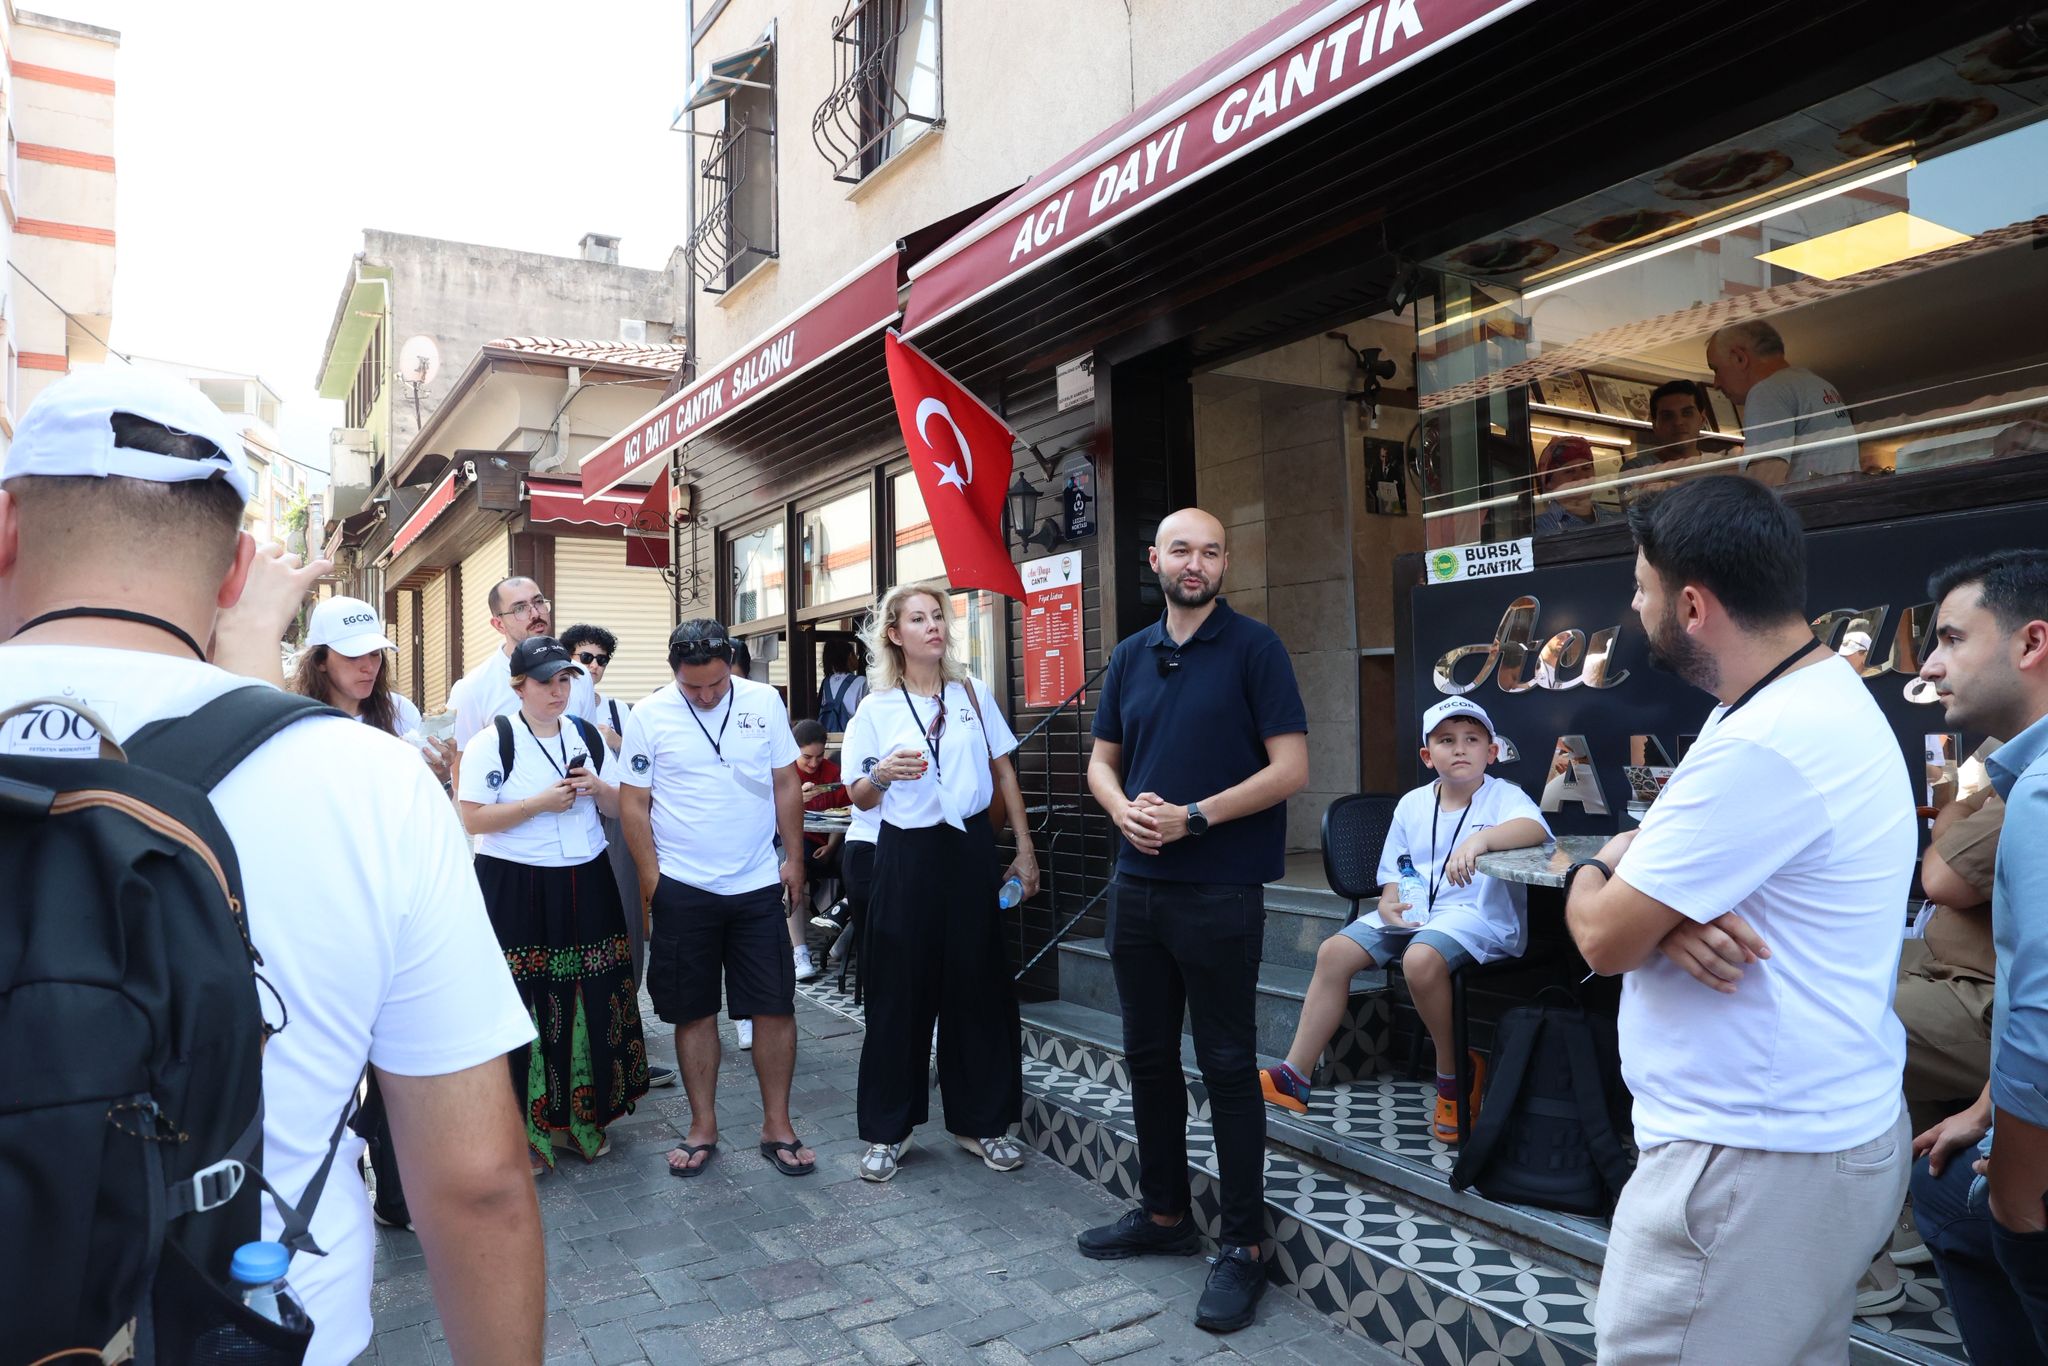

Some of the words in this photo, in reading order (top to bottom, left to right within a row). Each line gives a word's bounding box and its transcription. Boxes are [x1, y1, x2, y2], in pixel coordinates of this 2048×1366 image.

[1008, 189, 1075, 264] ACI
[1088, 121, 1188, 218] DAYI
[1212, 0, 1424, 144] CANTIK
[623, 432, 642, 468] ACI
[645, 413, 671, 454] DAYI
[675, 378, 725, 435] CANTIK
[731, 330, 796, 400] SALONU
[1465, 543, 1522, 562] BURSA
[1467, 558, 1523, 577] CANTIK
[1438, 700, 1475, 711] EGCON
